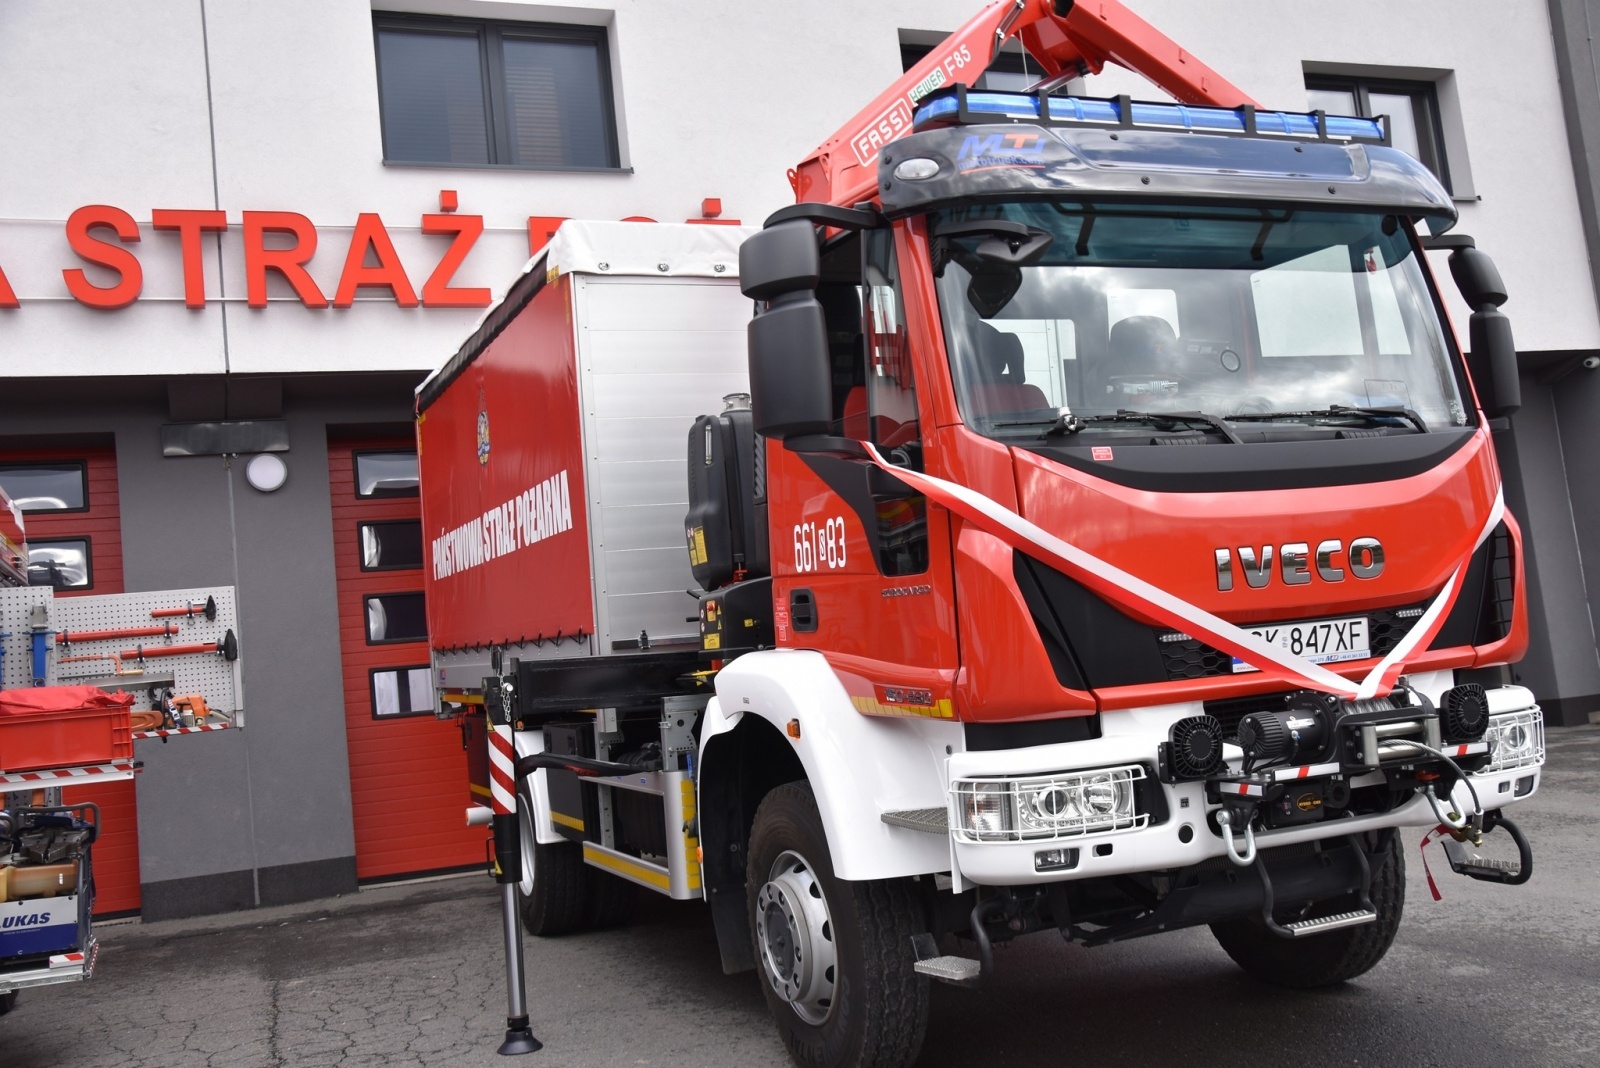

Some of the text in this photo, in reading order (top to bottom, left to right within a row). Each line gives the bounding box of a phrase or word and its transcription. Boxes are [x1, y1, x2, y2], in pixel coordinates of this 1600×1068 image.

[943, 44, 971, 77] F85
[858, 106, 909, 158] FASSI
[62, 190, 492, 311] STRAŻ
[432, 517, 485, 581] PAŃSTWOWA
[1214, 536, 1386, 592] IVECO
[882, 585, 931, 597] EUROCARGO
[1290, 620, 1362, 656] 847XF
[0, 912, 51, 929] UKAS
